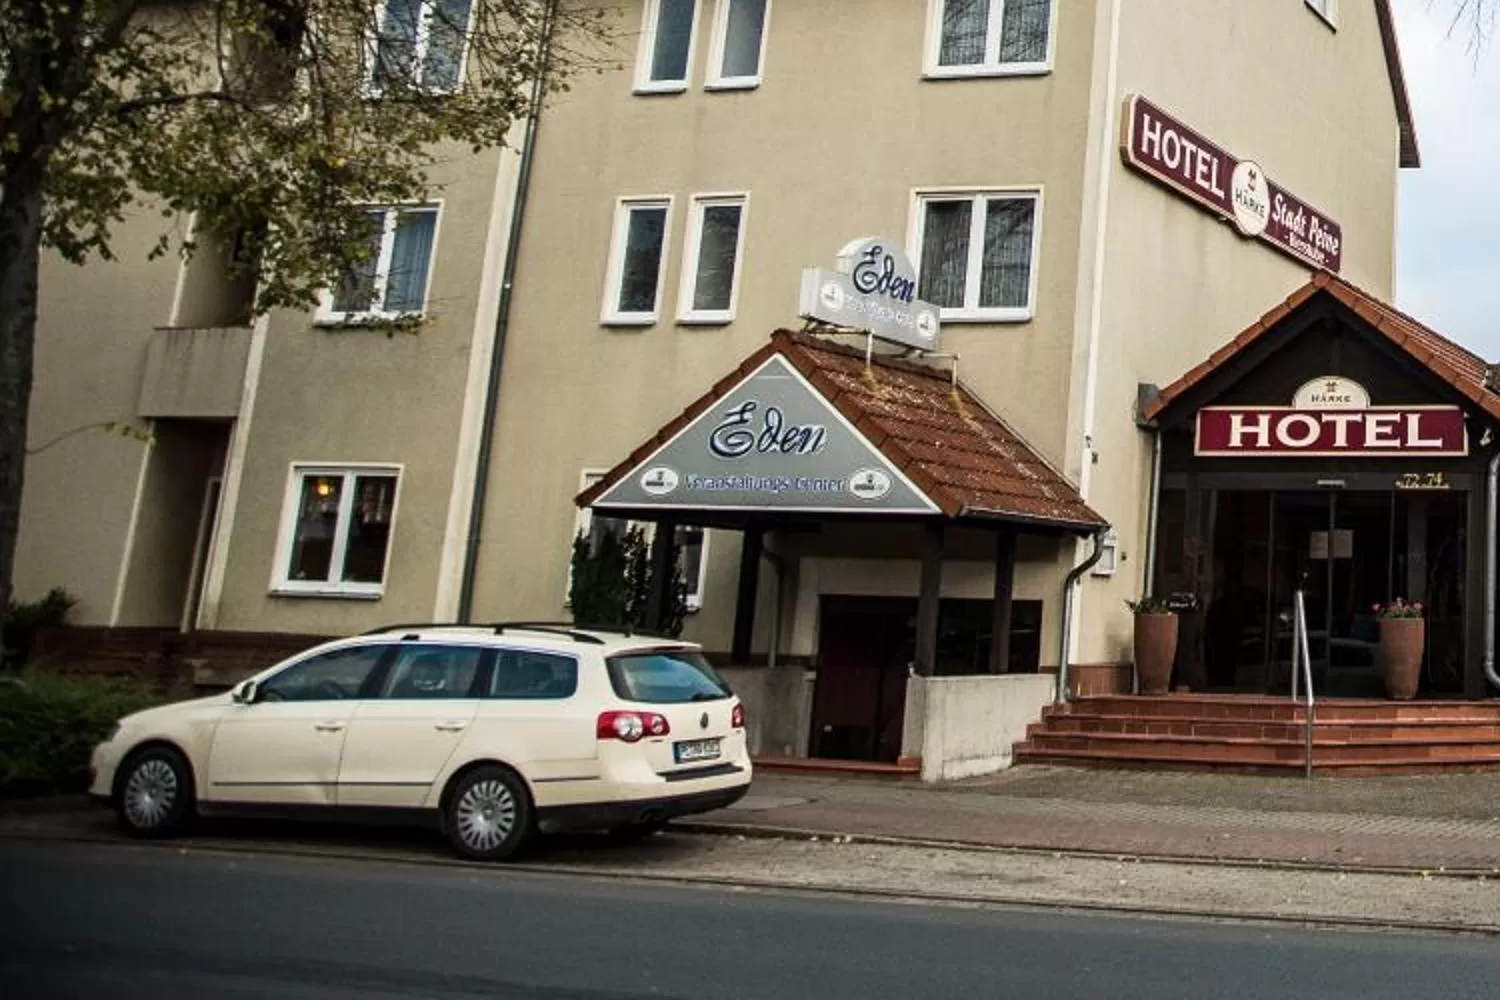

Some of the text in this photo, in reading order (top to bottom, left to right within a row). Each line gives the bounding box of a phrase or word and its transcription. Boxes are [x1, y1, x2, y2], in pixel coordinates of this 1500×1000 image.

[1141, 113, 1225, 200] HOTEL
[1234, 188, 1265, 220] HÄRKE
[1271, 192, 1340, 257] Stadt Peine
[853, 245, 915, 303] Eden
[709, 402, 826, 458] Eden
[1228, 412, 1443, 448] HOTEL
